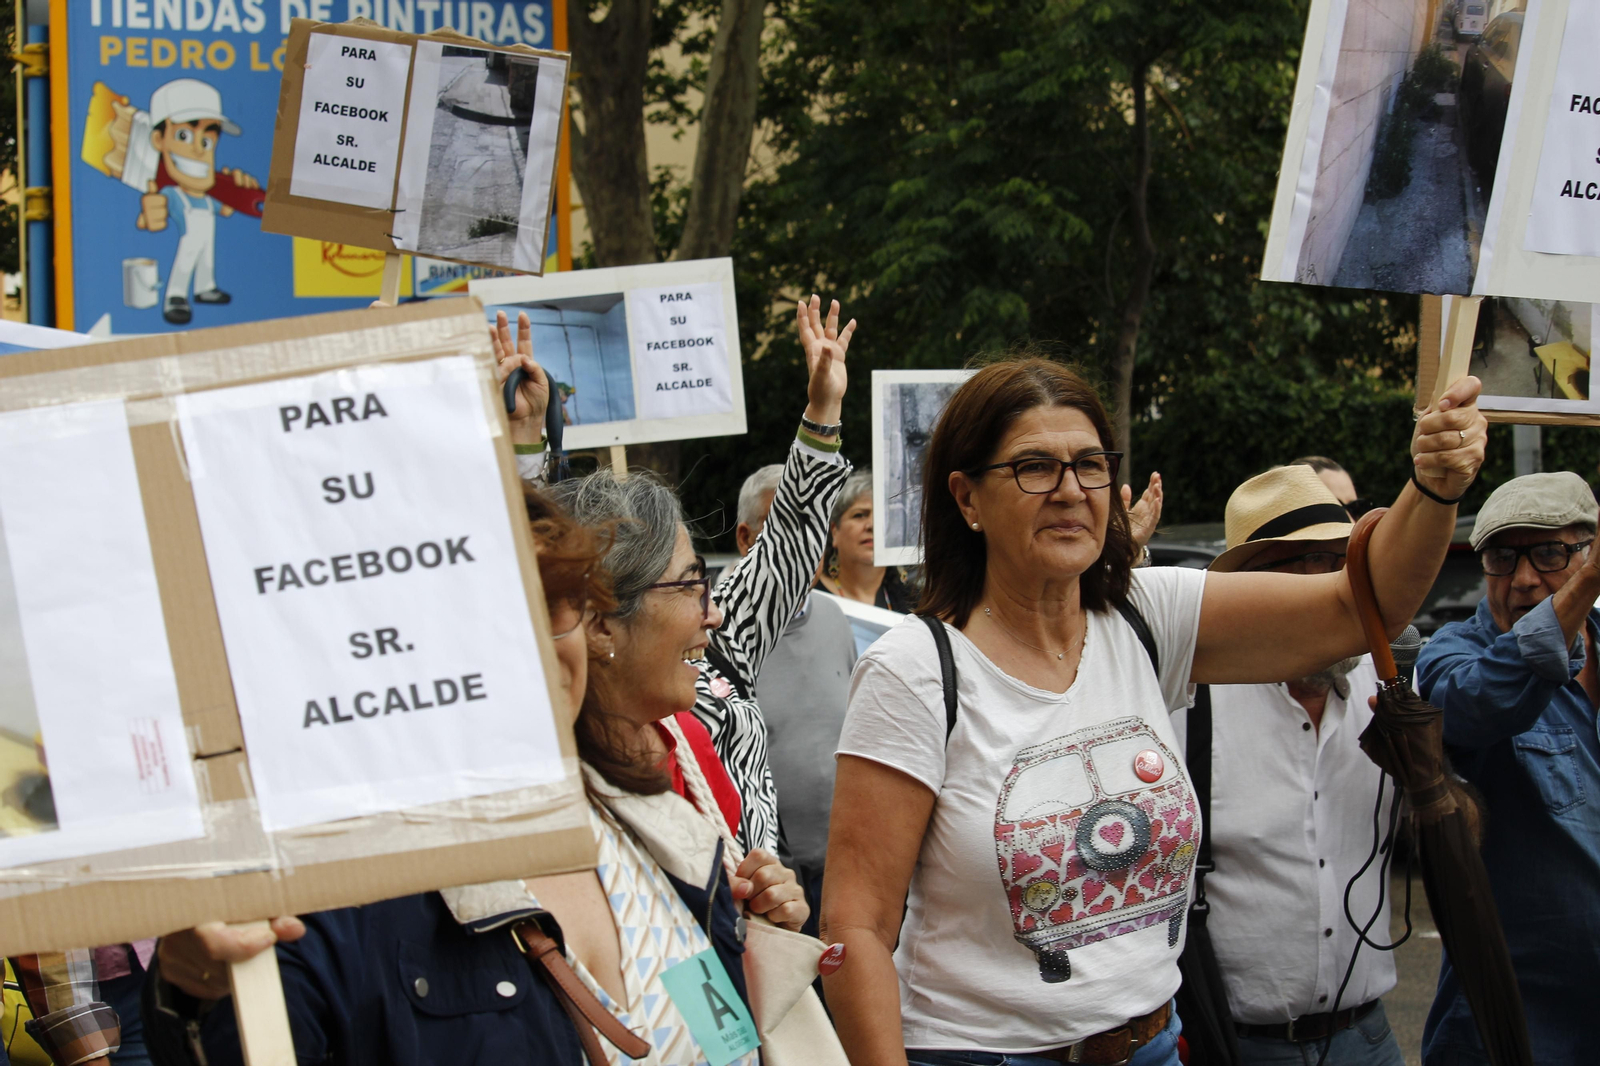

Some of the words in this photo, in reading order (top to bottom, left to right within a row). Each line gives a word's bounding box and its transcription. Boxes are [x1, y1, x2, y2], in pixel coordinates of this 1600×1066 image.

[91, 0, 266, 34] TIENDAS
[347, 0, 545, 44] PINTURAS
[100, 36, 236, 70] PEDRO
[341, 46, 377, 61] PARA
[346, 76, 365, 89] SU
[314, 101, 389, 122] FACEBOOK
[336, 134, 358, 148] SR.
[313, 153, 377, 173] ALCALDE
[1560, 179, 1600, 201] ALC
[660, 292, 693, 303] PARA
[670, 316, 687, 326] SU
[646, 337, 714, 351] FACEBOOK
[672, 362, 693, 373] SR.
[655, 378, 713, 392] ALCALDE
[279, 393, 389, 433] PARA
[321, 472, 376, 504] SU
[253, 536, 477, 595] FACEBOOK
[348, 627, 415, 659] SR.
[302, 673, 488, 729] ALCALDE
